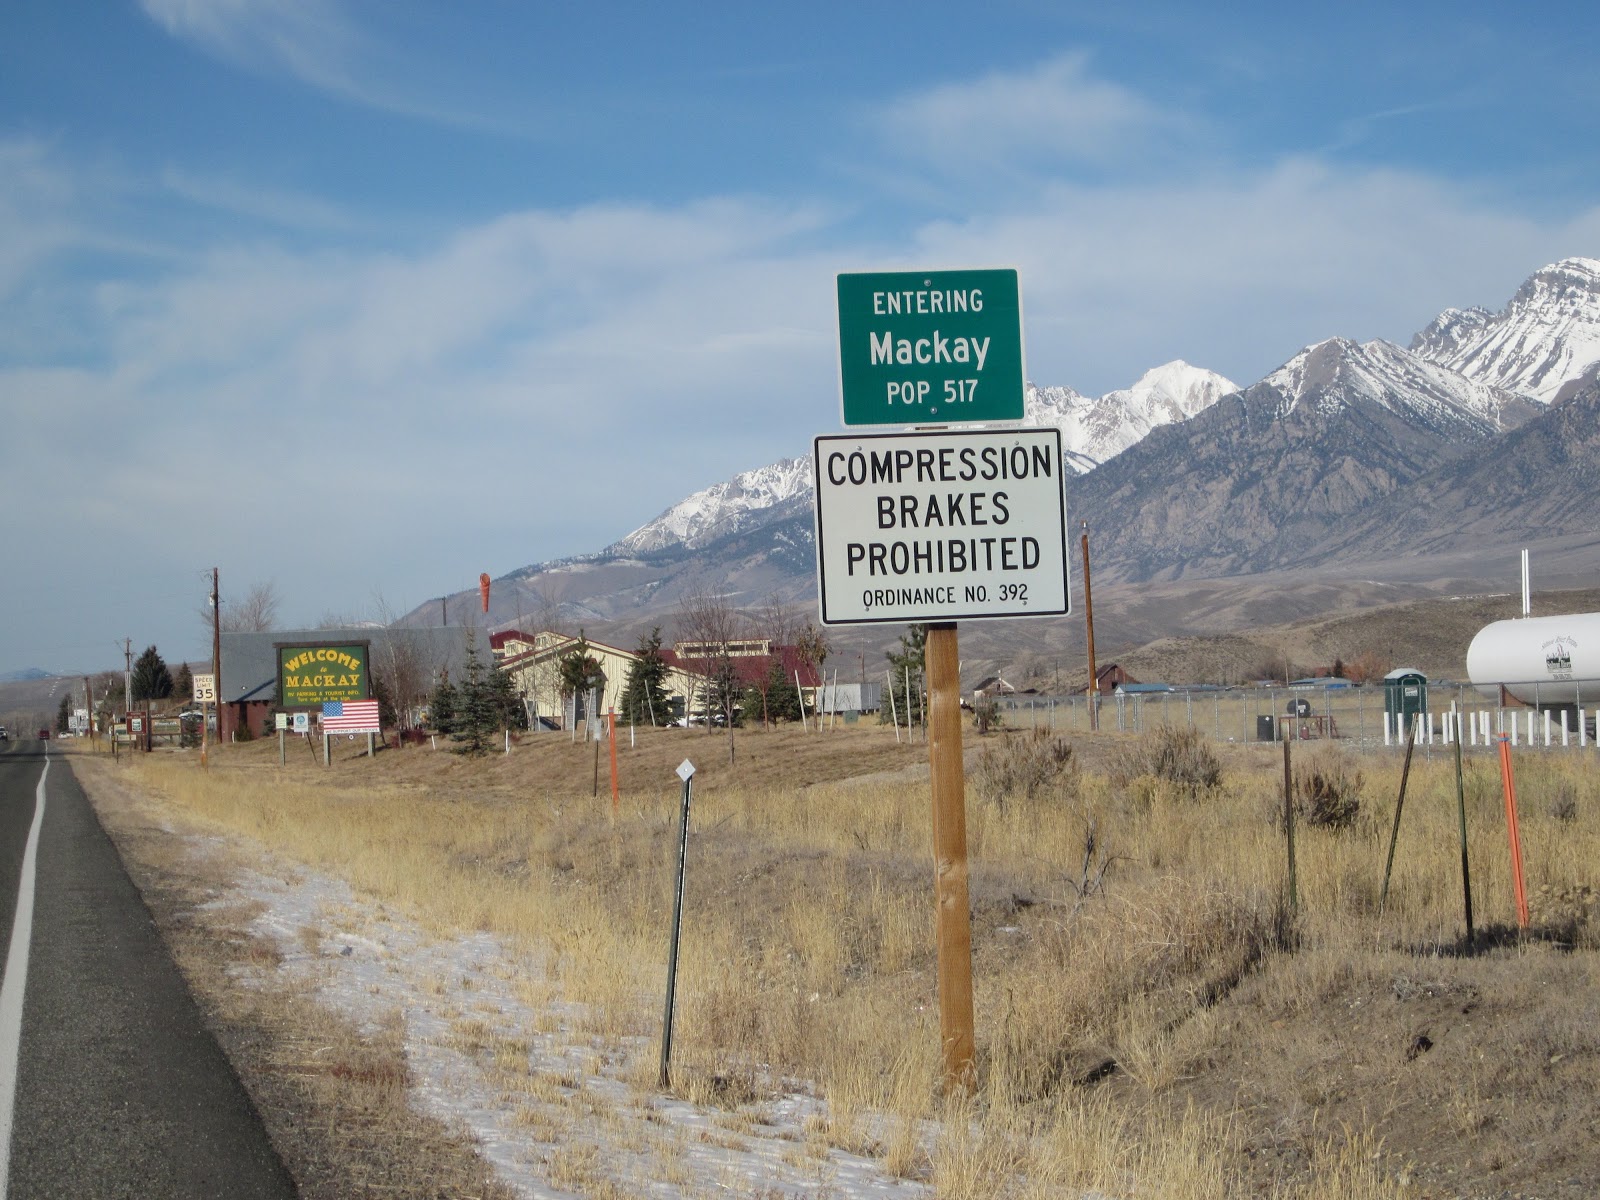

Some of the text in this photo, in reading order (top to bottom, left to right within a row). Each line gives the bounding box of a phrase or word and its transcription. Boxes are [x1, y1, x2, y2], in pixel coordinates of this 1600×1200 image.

[873, 289, 983, 315] ENTERING
[869, 330, 990, 371] Mackay
[887, 379, 979, 405] POP 517
[827, 445, 1052, 486] COMPRESSION
[877, 491, 1010, 529] BRAKES
[847, 536, 1041, 577] PROHIBITED
[863, 583, 1028, 606] ORDINANCE NO. 392
[285, 649, 361, 672] WELCOME
[196, 688, 213, 699] 35
[286, 674, 360, 687] MACKAY
